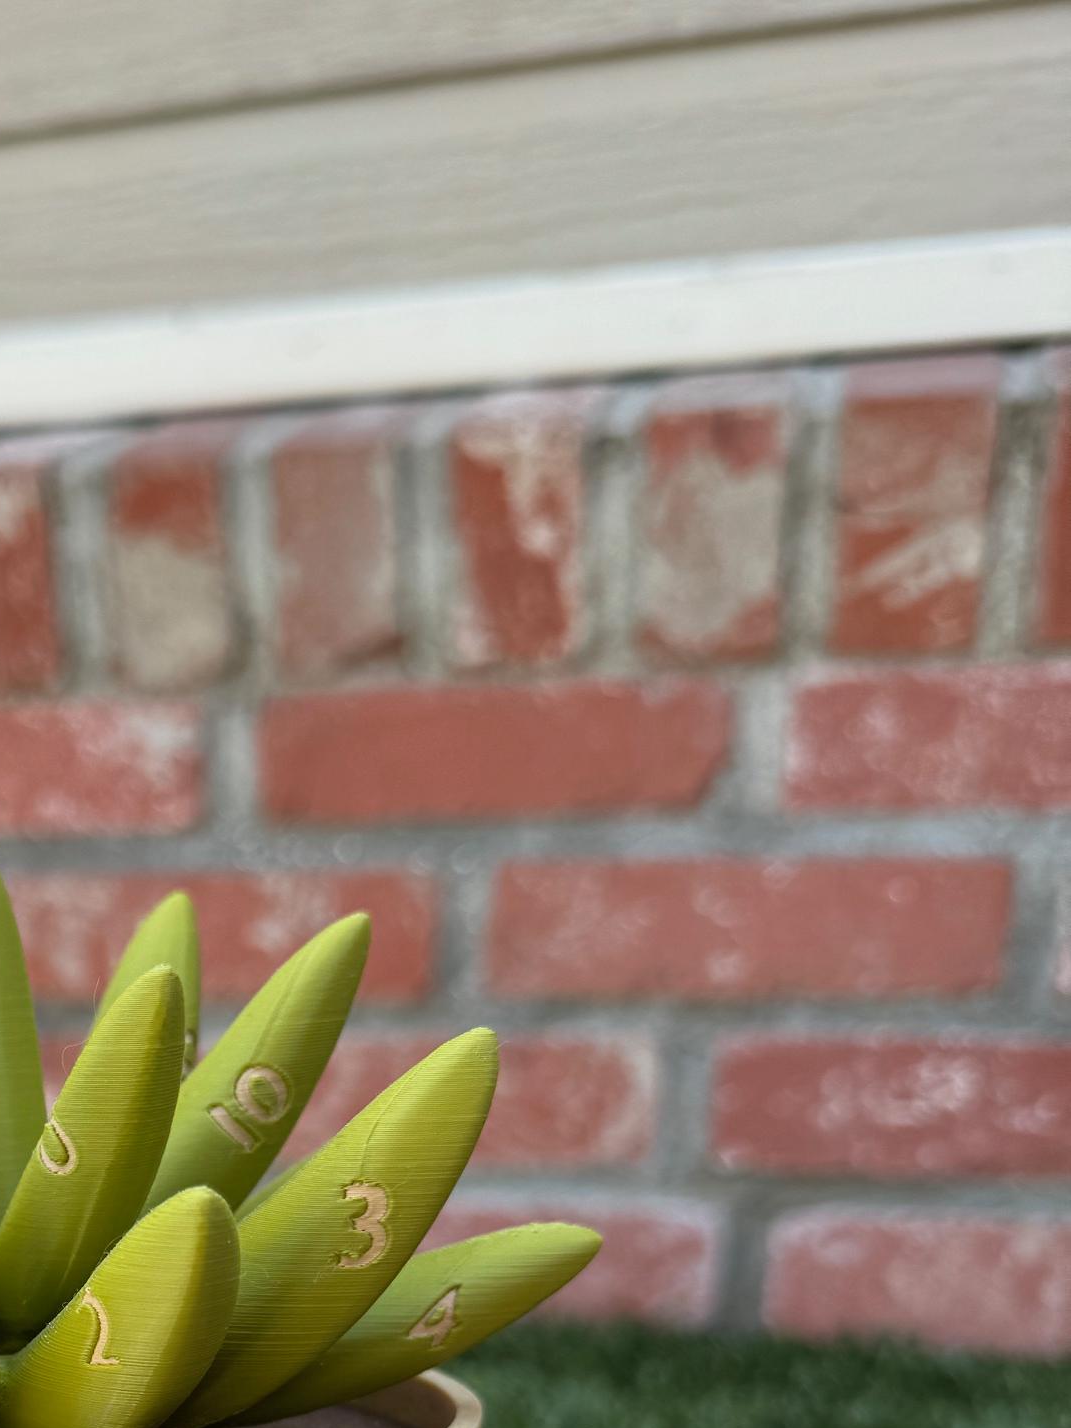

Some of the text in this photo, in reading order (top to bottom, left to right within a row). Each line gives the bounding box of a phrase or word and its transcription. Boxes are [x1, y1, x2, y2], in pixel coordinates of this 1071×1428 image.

[208, 1065, 288, 1151] 10
[338, 1181, 388, 1268] 3
[81, 1288, 120, 1365] 2
[406, 1286, 460, 1348] 4
